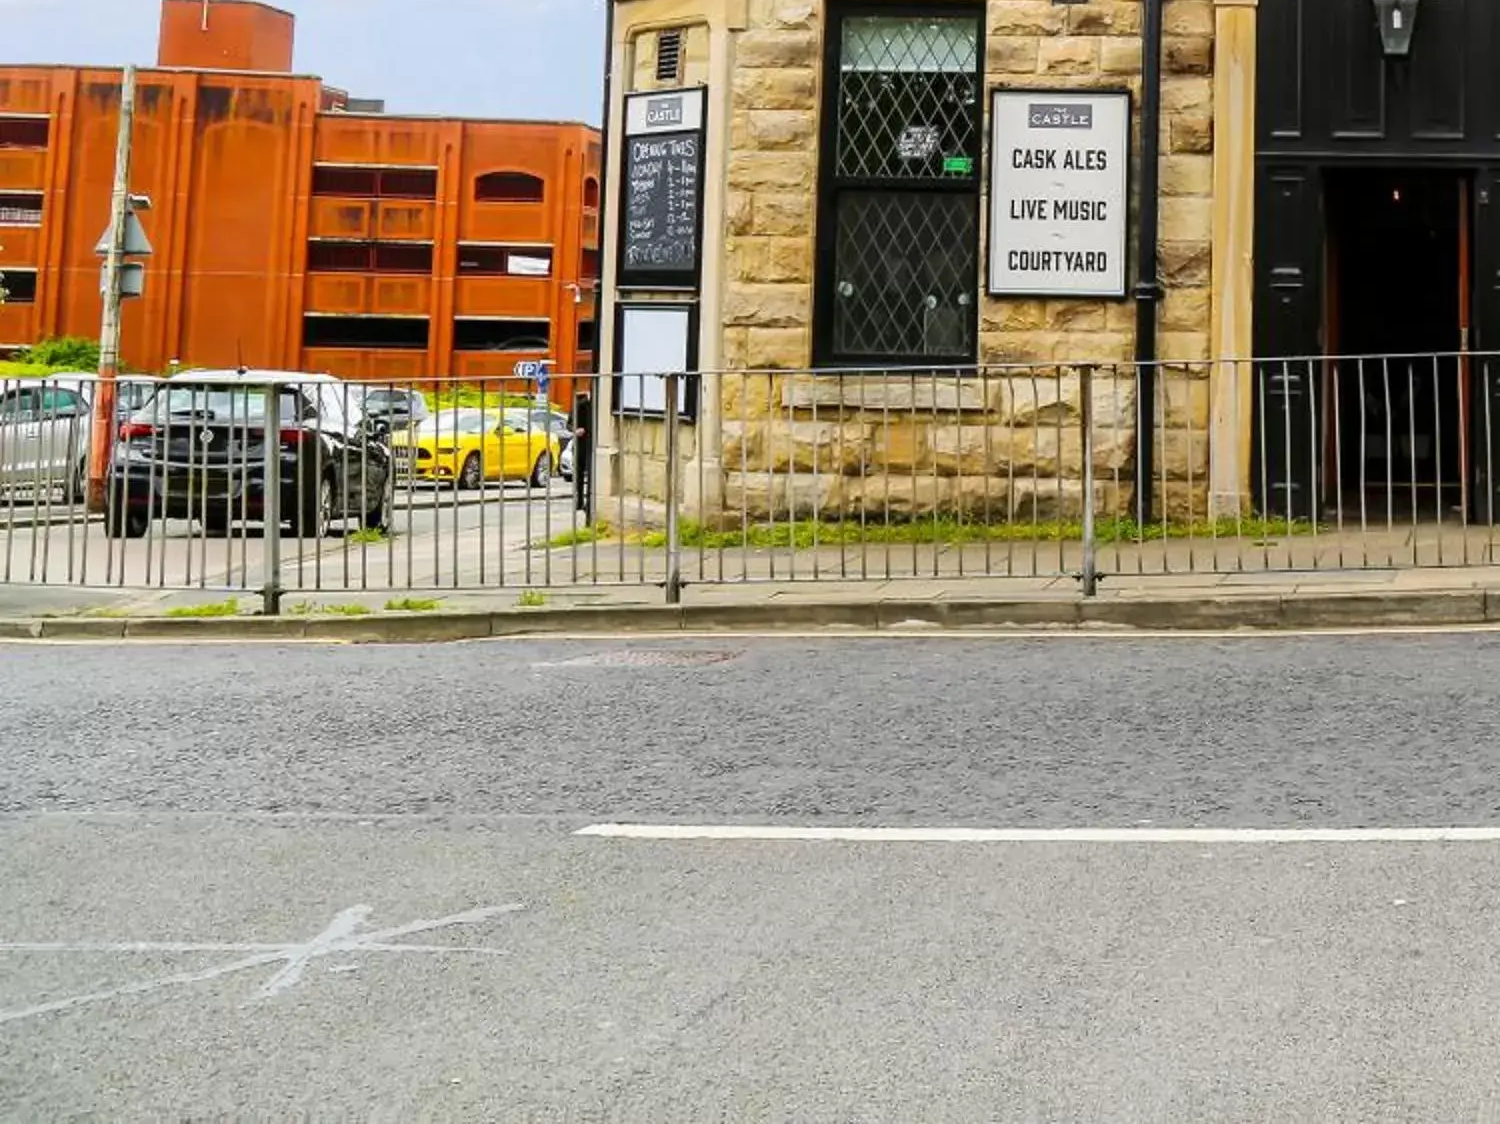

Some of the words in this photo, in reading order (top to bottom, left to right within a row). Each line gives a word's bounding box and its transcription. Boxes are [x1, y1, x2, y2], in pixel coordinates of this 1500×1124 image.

[647, 109, 681, 123] CASTLE
[1031, 114, 1089, 125] CASTLE
[1012, 148, 1056, 170] CASK
[1063, 149, 1107, 170] ALES
[1010, 199, 1047, 220] LIVE
[1053, 201, 1107, 221] MUSIC
[1008, 250, 1107, 272] COURTYARD
